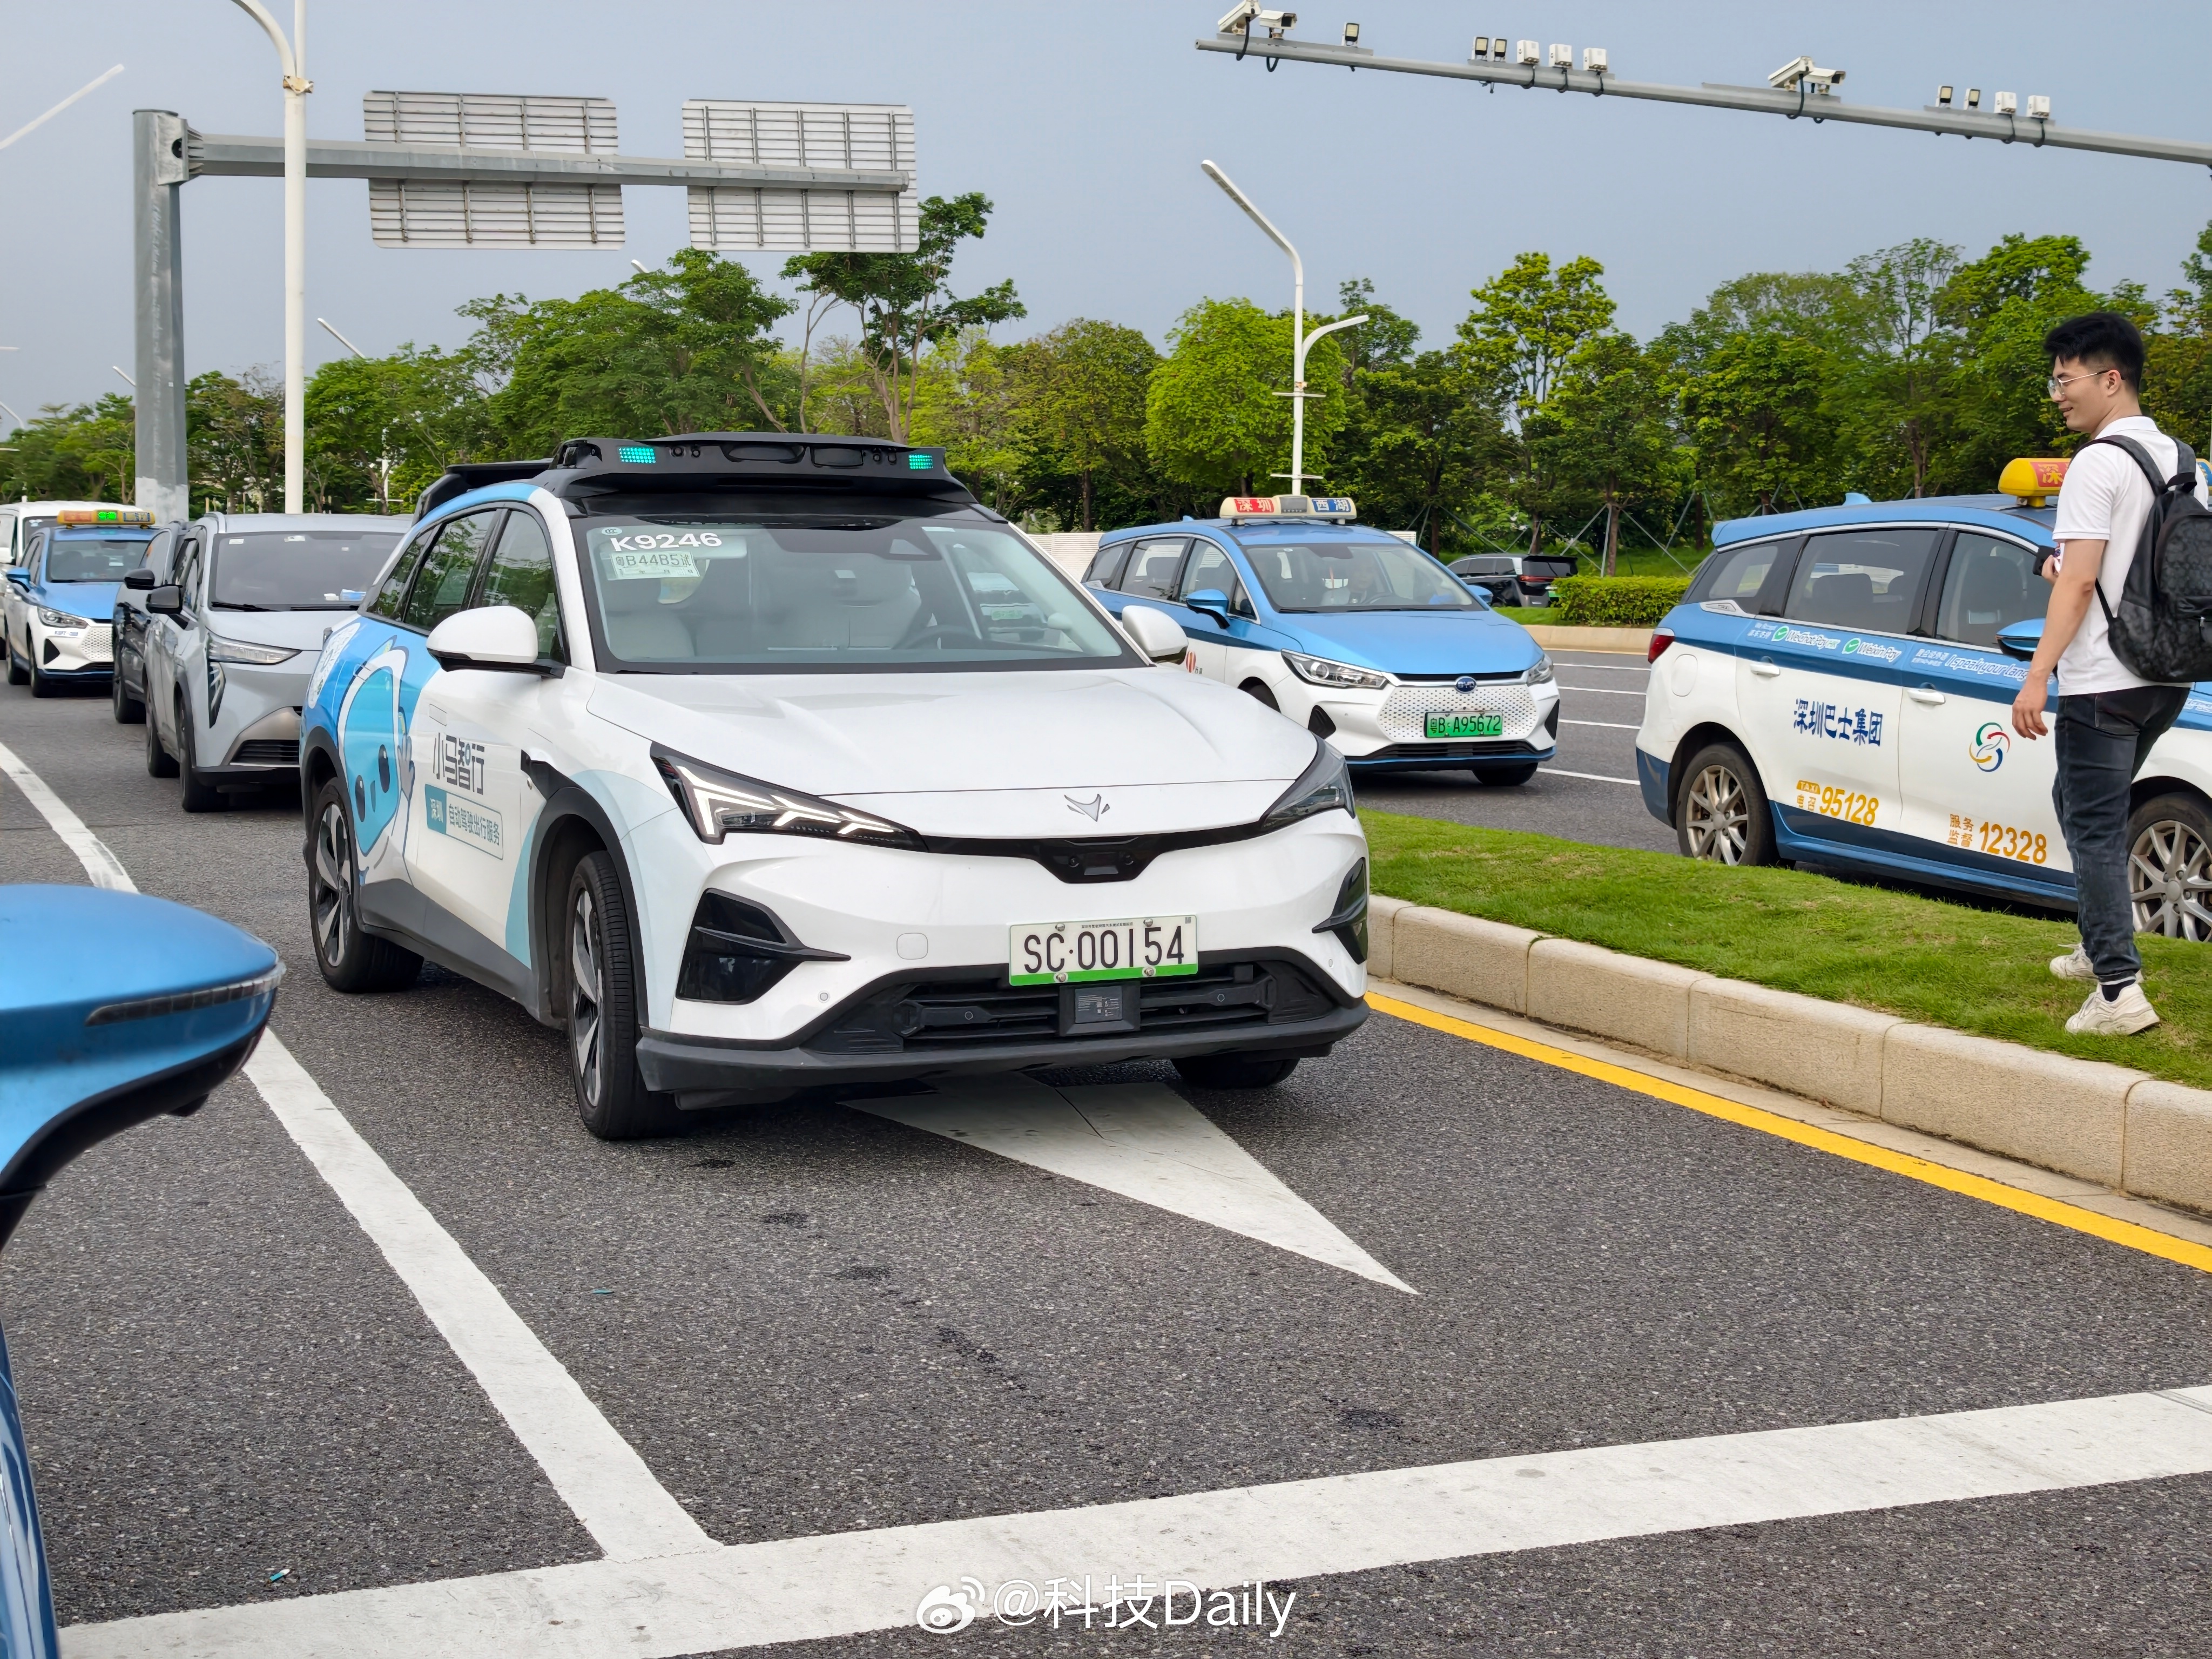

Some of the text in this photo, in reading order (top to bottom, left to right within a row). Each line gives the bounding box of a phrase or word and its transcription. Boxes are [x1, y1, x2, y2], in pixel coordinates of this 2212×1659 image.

[2038, 463, 2071, 484] 深
[1237, 498, 1272, 511] 深圳
[1313, 498, 1349, 511] 西湖
[610, 532, 722, 551] K9246
[1786, 630, 1816, 646] WeChat
[1815, 635, 1829, 650] Pay
[1857, 642, 1886, 658] Weixin
[1884, 646, 1902, 663] Pay
[1951, 658, 1983, 670] speak
[1977, 662, 2006, 675] your
[1793, 698, 1883, 747] 深圳巴士集团
[433, 732, 485, 795] 小马智行
[1800, 781, 1819, 793] TAXI
[1819, 786, 1879, 826] 95128
[448, 803, 500, 846] 自动驾驶出行服务
[1950, 813, 1974, 832] 服务
[1946, 829, 1973, 847] 监督
[1979, 821, 2047, 864] 12328
